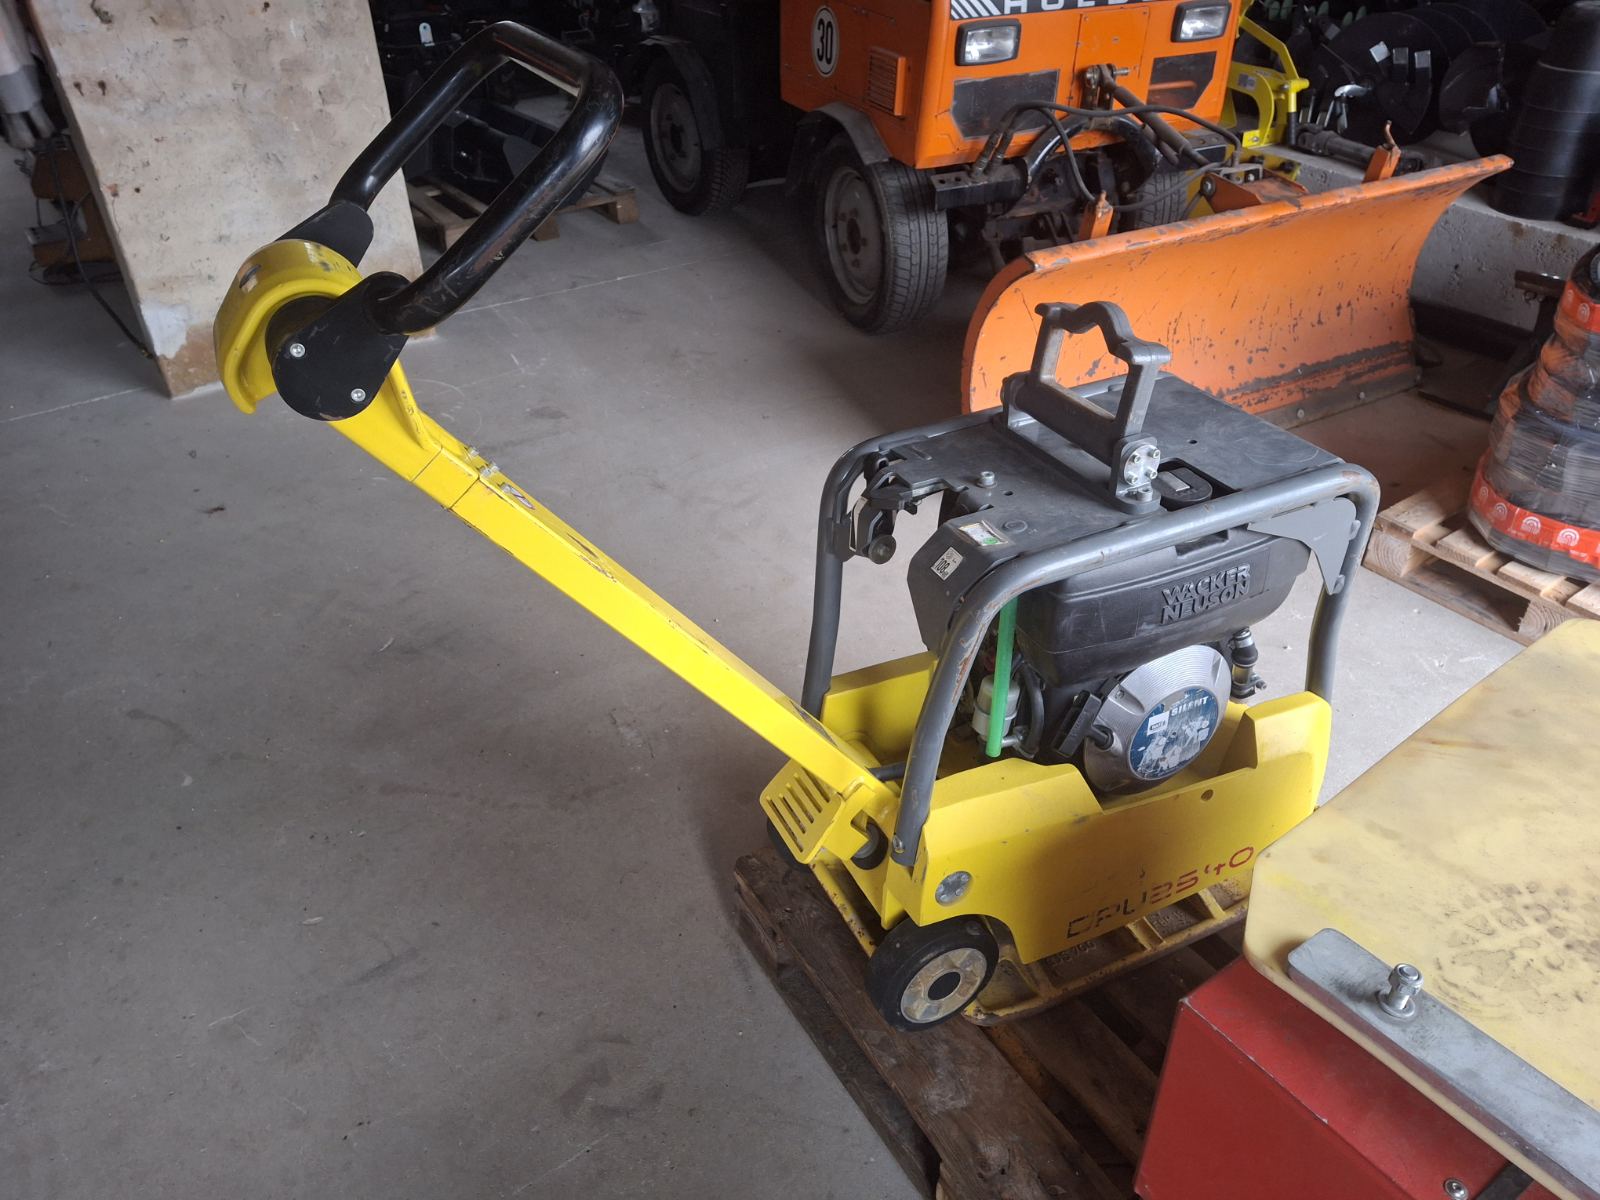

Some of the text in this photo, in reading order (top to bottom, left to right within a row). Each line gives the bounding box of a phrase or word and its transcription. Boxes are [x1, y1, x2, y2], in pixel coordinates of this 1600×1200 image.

[817, 18, 833, 65] 30
[1161, 564, 1251, 605] WACKER
[1161, 582, 1250, 624] NEUSON
